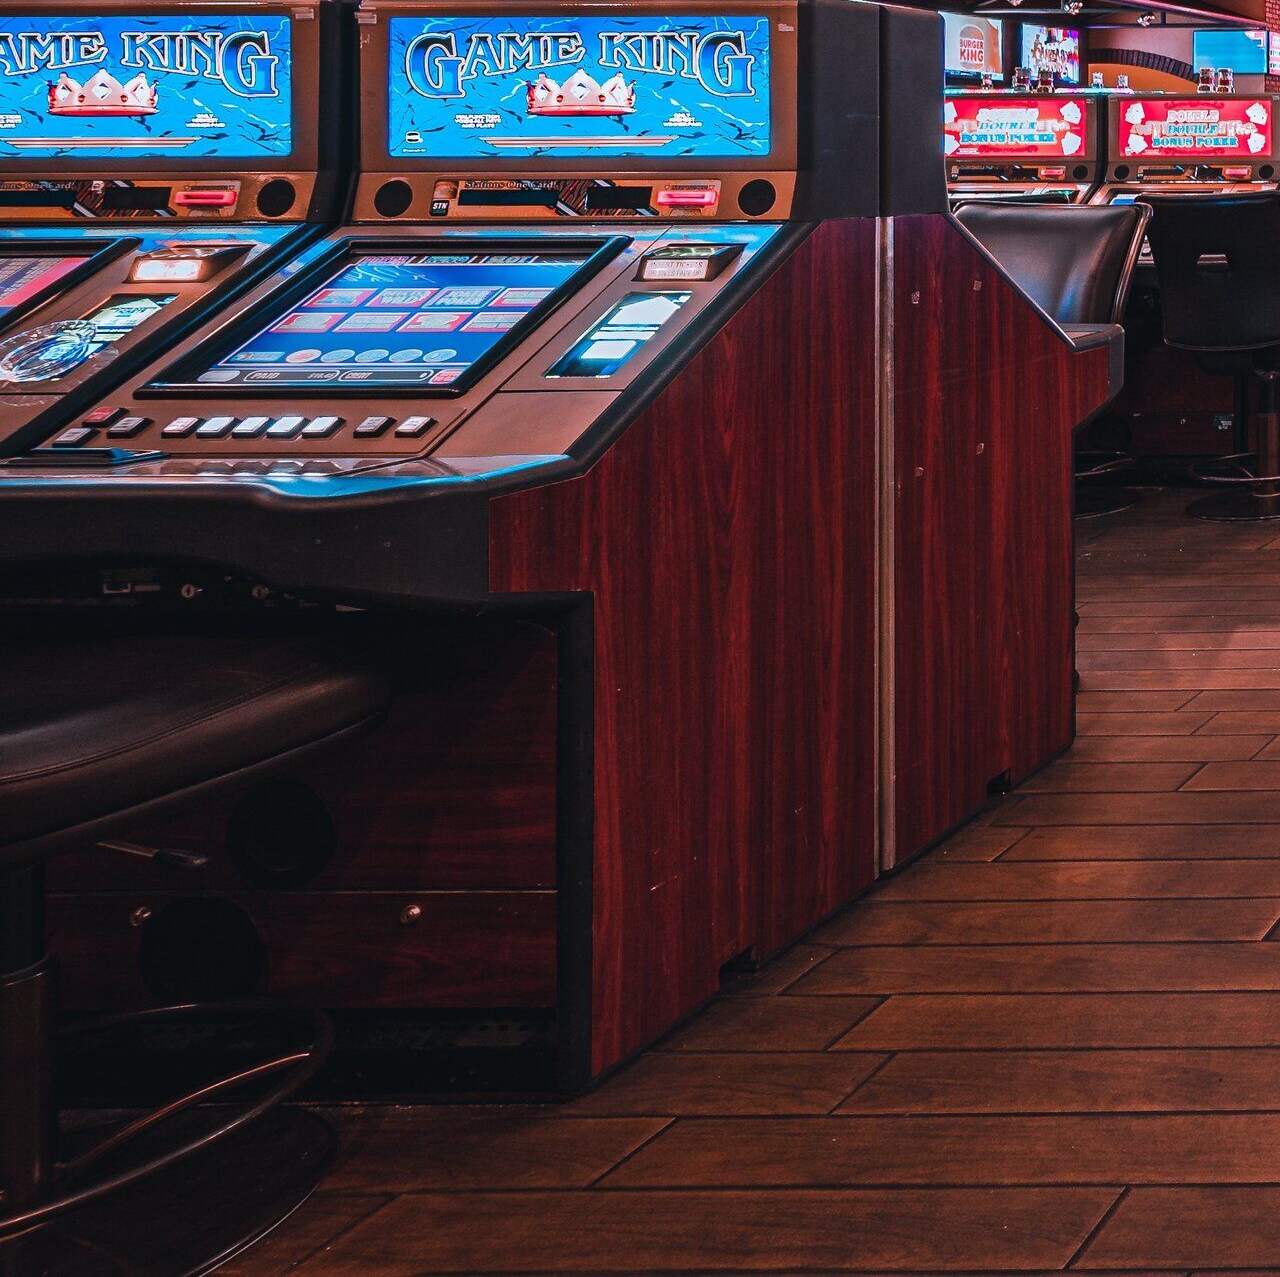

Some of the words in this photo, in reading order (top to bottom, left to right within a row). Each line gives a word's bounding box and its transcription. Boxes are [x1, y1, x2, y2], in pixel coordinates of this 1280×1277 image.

[959, 39, 984, 50] BURGER
[959, 49, 984, 62] KING
[120, 30, 280, 98] KING
[405, 31, 586, 99] GAME
[599, 30, 756, 97] KING
[1167, 109, 1220, 122] DOUBLE
[1167, 123, 1219, 134] DOUBLE
[960, 132, 1007, 144] BONUS
[1152, 136, 1193, 147] BONUS
[1196, 136, 1238, 147] POKER
[250, 372, 280, 380] PAID
